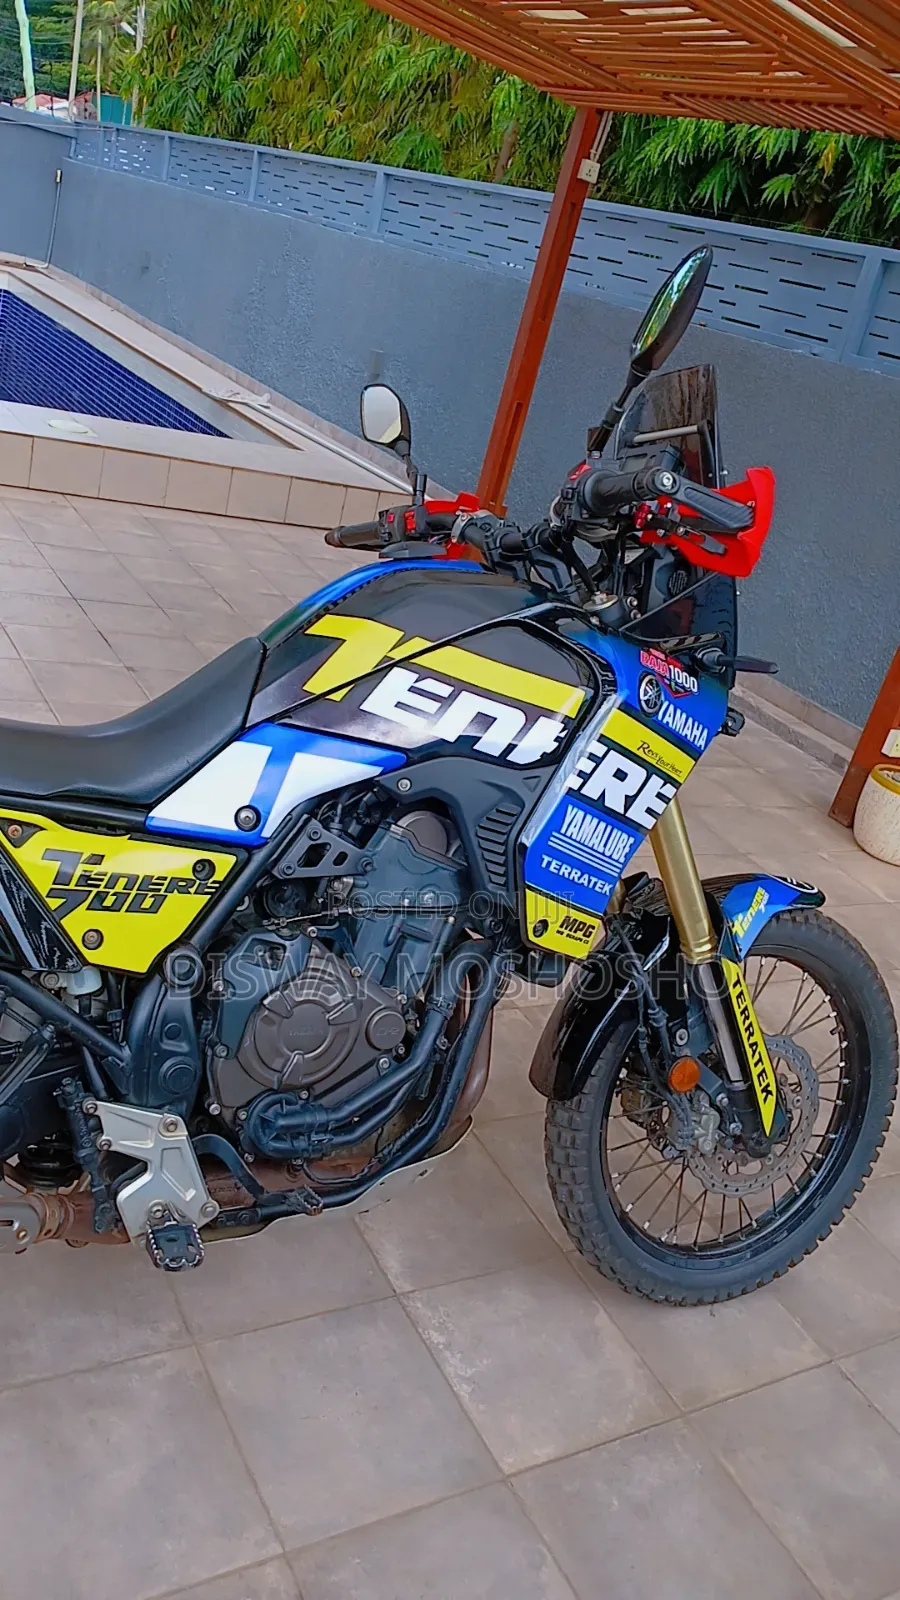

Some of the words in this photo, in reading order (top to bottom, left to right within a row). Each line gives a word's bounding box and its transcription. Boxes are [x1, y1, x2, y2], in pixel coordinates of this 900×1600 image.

[669, 665, 698, 693] 1000
[658, 700, 708, 750] YAMAHA
[560, 803, 635, 864] YAMALUBE
[541, 854, 614, 896] TERRATEK
[559, 915, 596, 938] MPG
[731, 972, 774, 1105] TERRATEK
